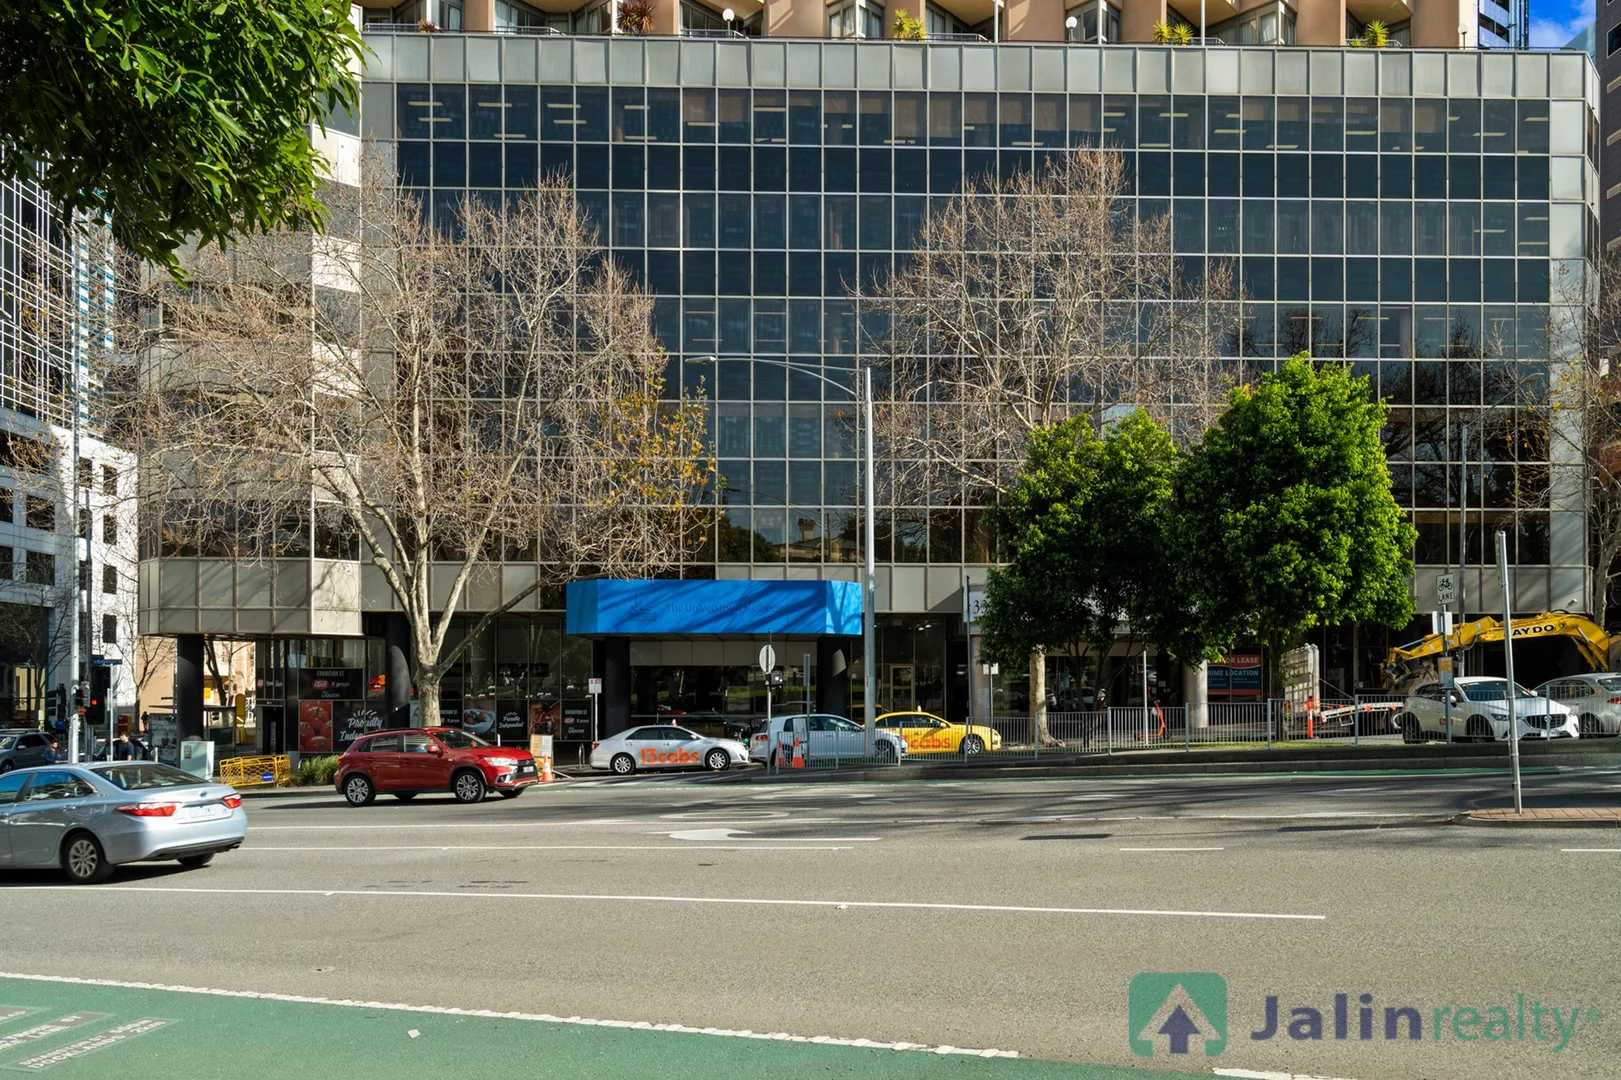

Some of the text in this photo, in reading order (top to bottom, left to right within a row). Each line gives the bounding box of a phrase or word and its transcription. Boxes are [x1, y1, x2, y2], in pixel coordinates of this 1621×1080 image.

[1438, 592, 1453, 602] LANE
[686, 602, 732, 614] University
[745, 602, 794, 613] Melbourn
[1509, 624, 1555, 636] AYDO
[348, 717, 382, 729] Proudly
[902, 734, 951, 750] cabs
[640, 748, 700, 764] 13cabs
